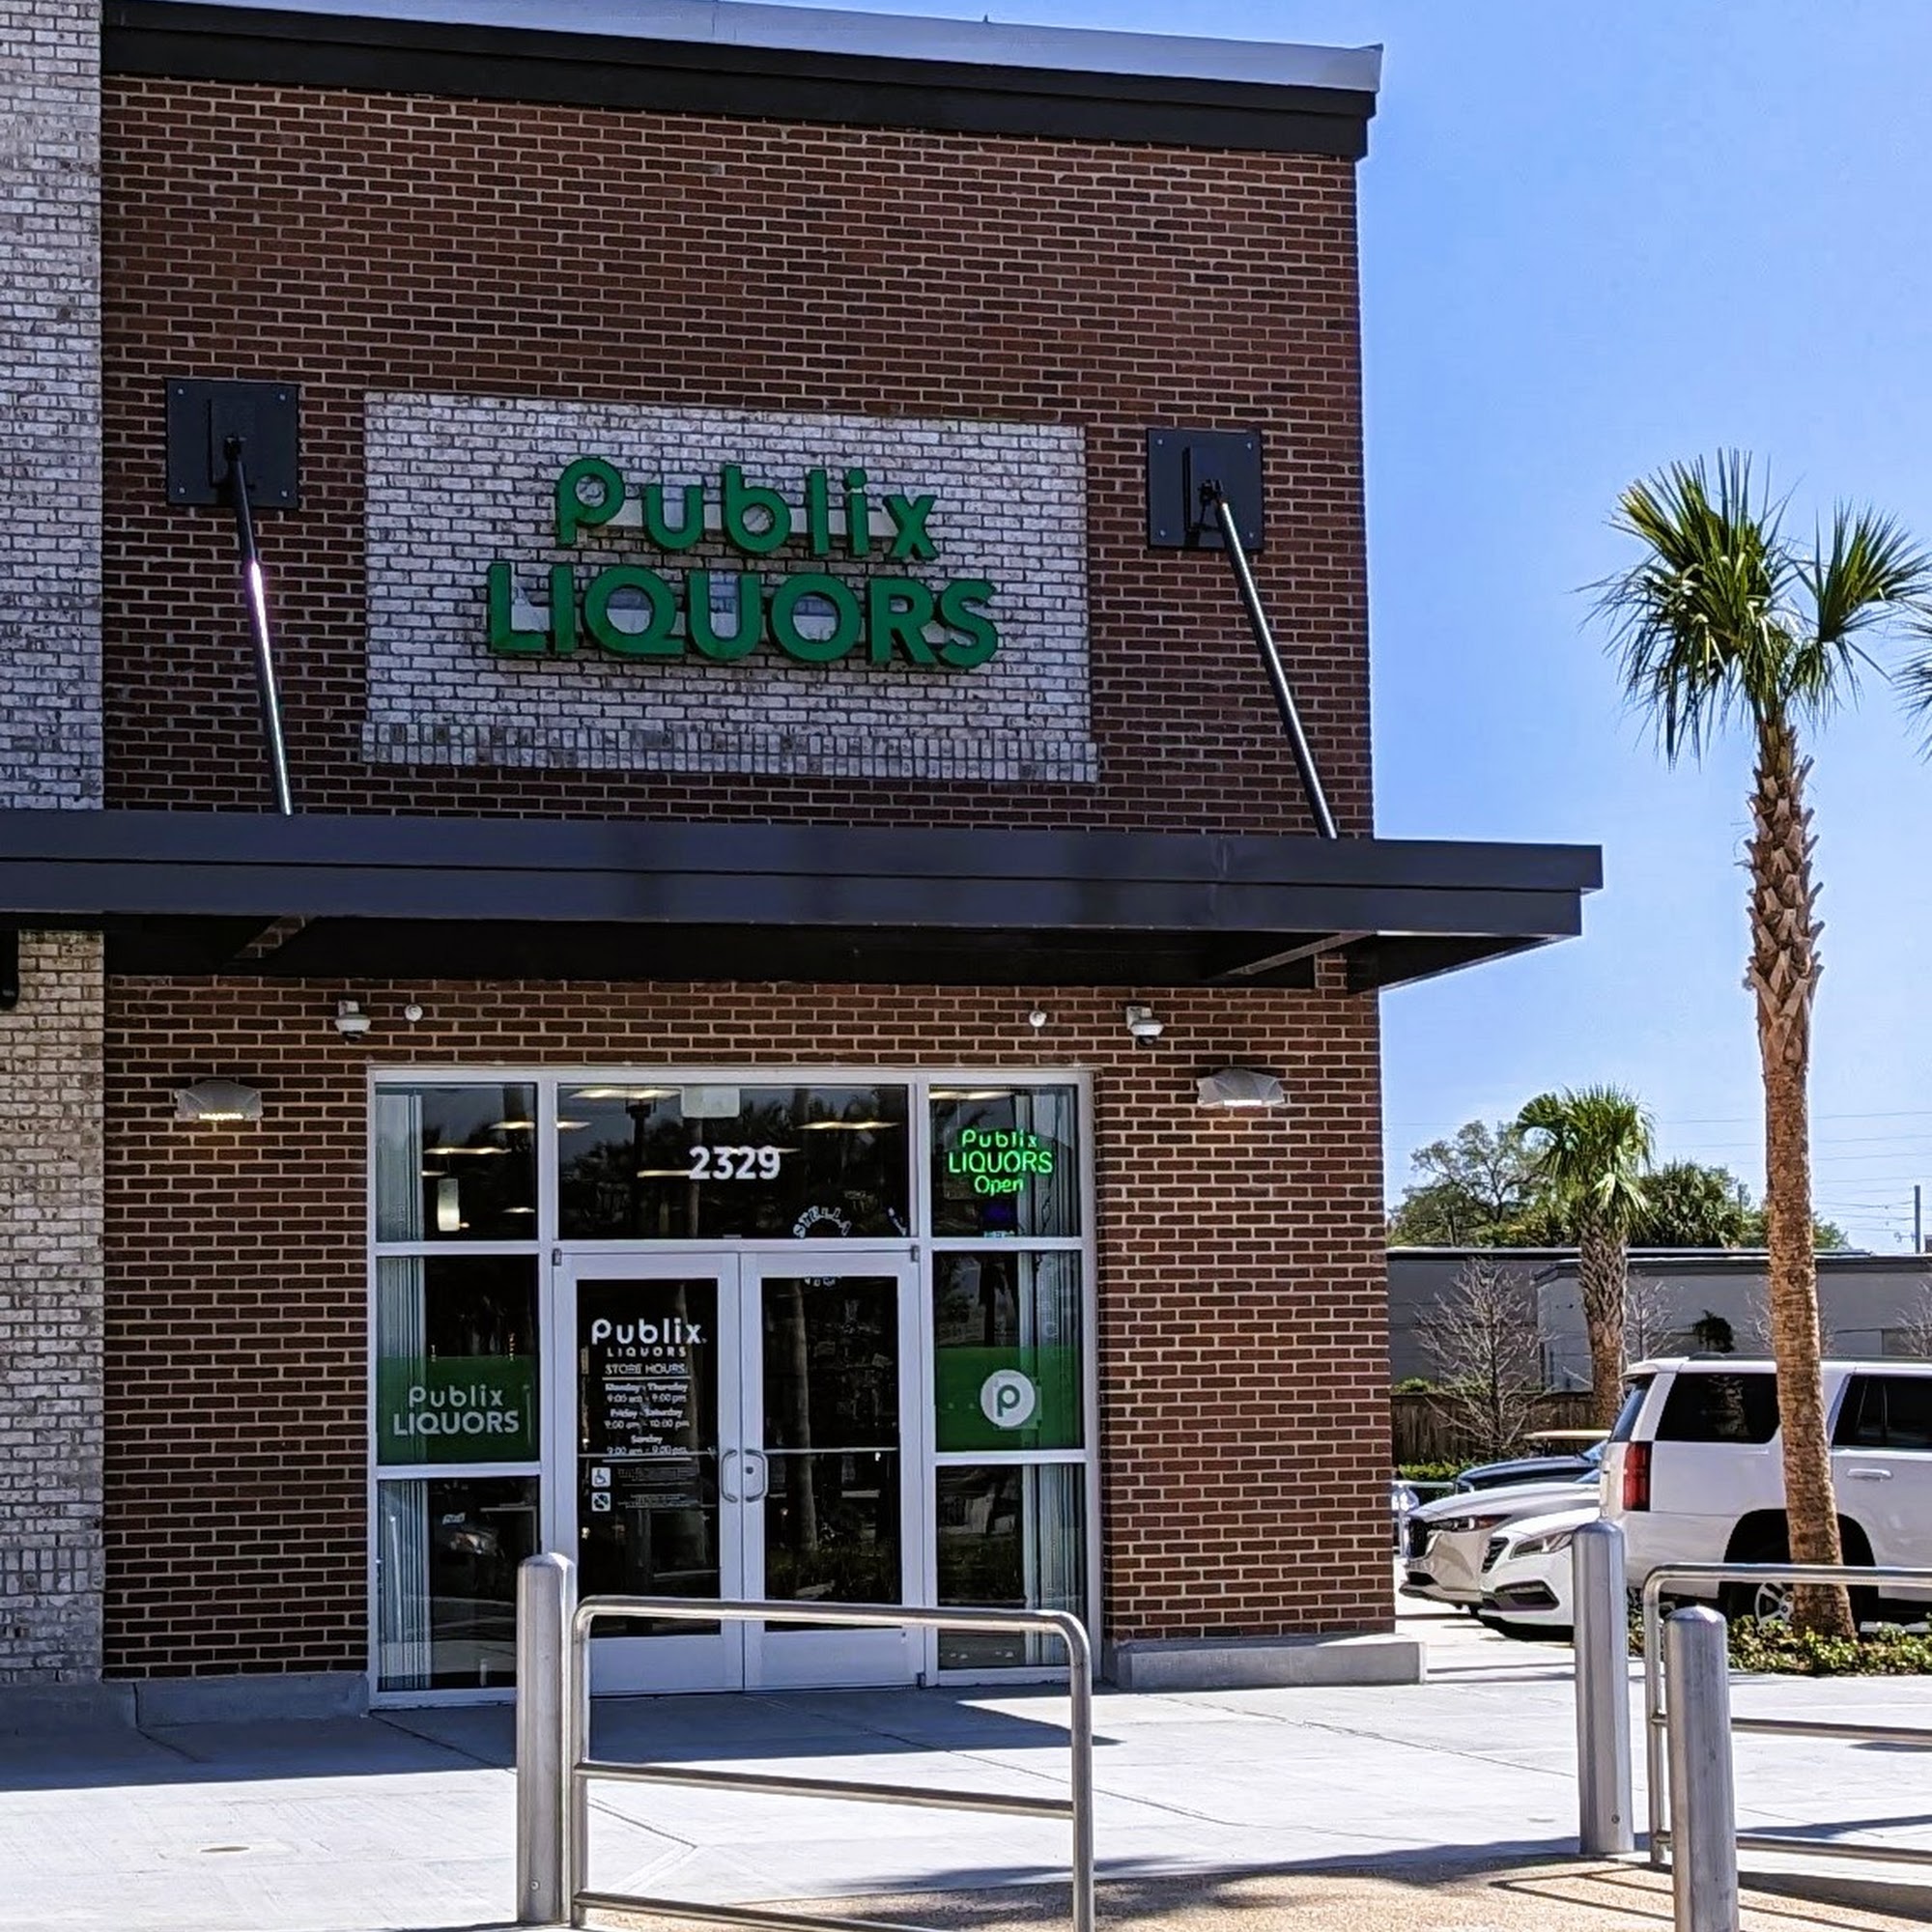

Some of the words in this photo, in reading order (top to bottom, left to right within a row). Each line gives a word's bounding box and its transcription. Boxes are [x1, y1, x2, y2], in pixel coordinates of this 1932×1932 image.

[554, 457, 939, 560] Publix
[486, 562, 999, 668] LIQUORS
[961, 1128, 1037, 1149] Publix
[689, 1145, 781, 1180] 2329
[949, 1150, 1053, 1174] LIQUORS
[974, 1175, 1024, 1197] Open
[591, 1318, 702, 1345] Publix
[607, 1347, 687, 1358] LIQUORS
[409, 1384, 503, 1408] Publix
[393, 1410, 520, 1436] LIQUORS
